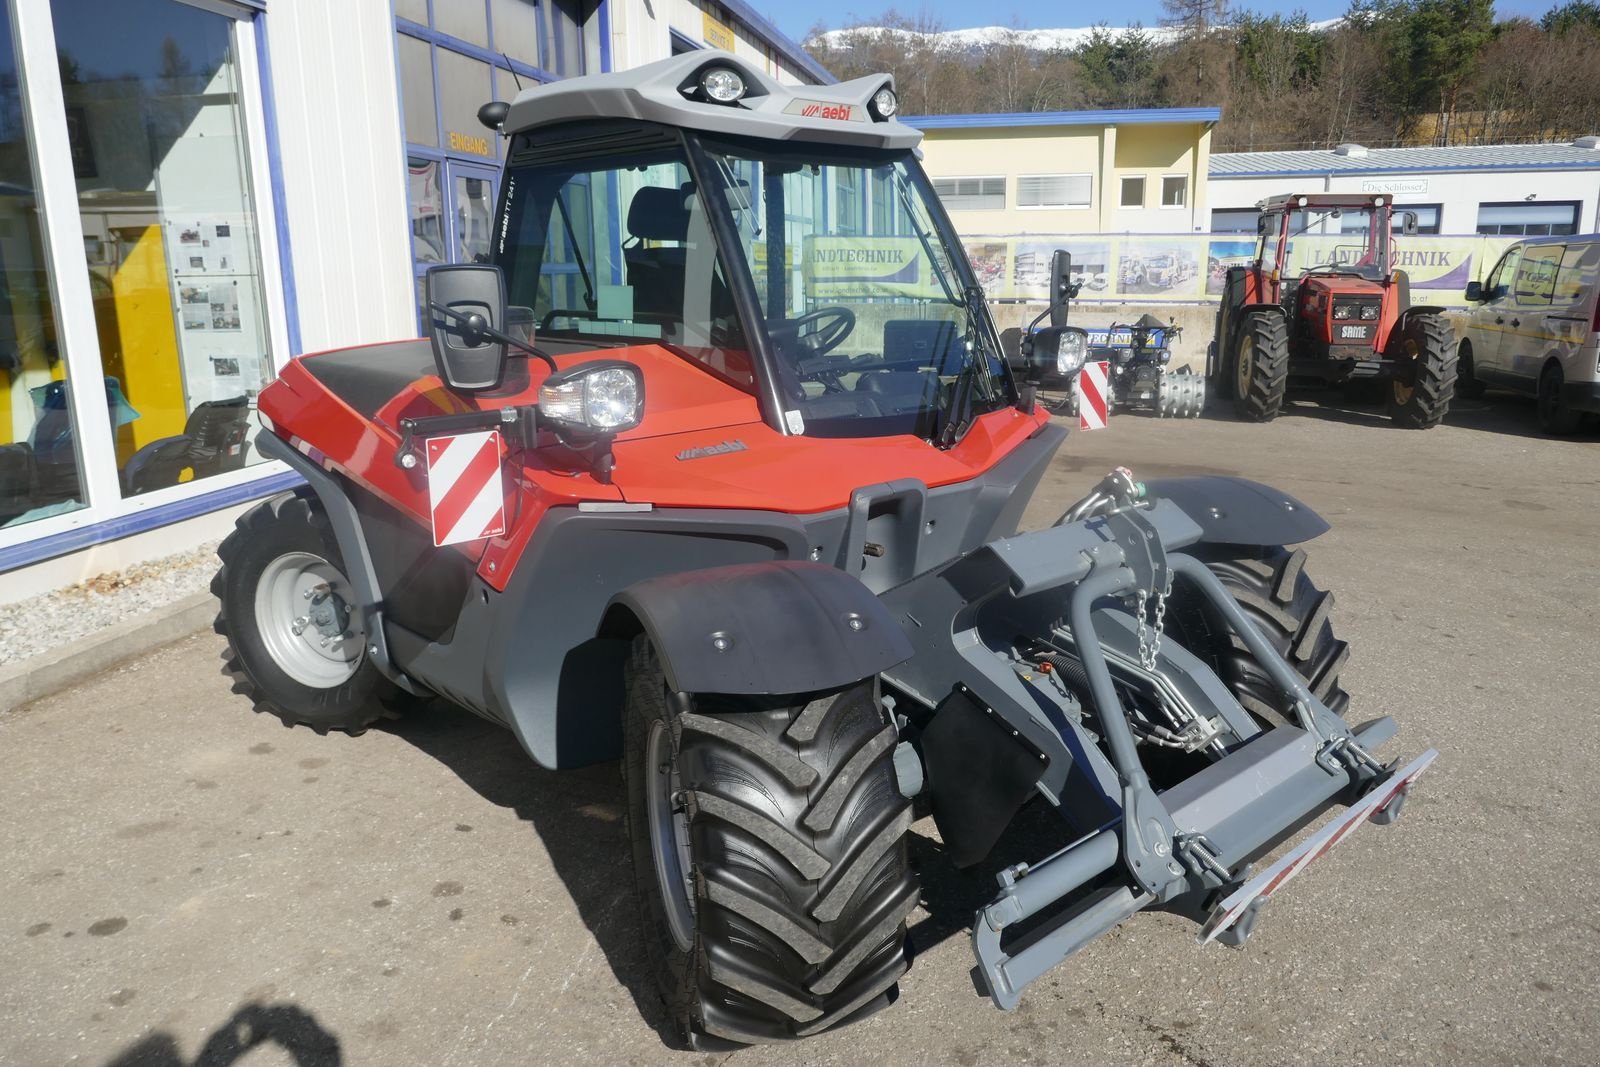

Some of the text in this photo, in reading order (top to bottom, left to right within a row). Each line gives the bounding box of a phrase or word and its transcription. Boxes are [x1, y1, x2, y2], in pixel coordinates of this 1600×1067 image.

[822, 105, 851, 121] aebi
[450, 132, 488, 155] EINGANG
[1341, 326, 1367, 338] SAME
